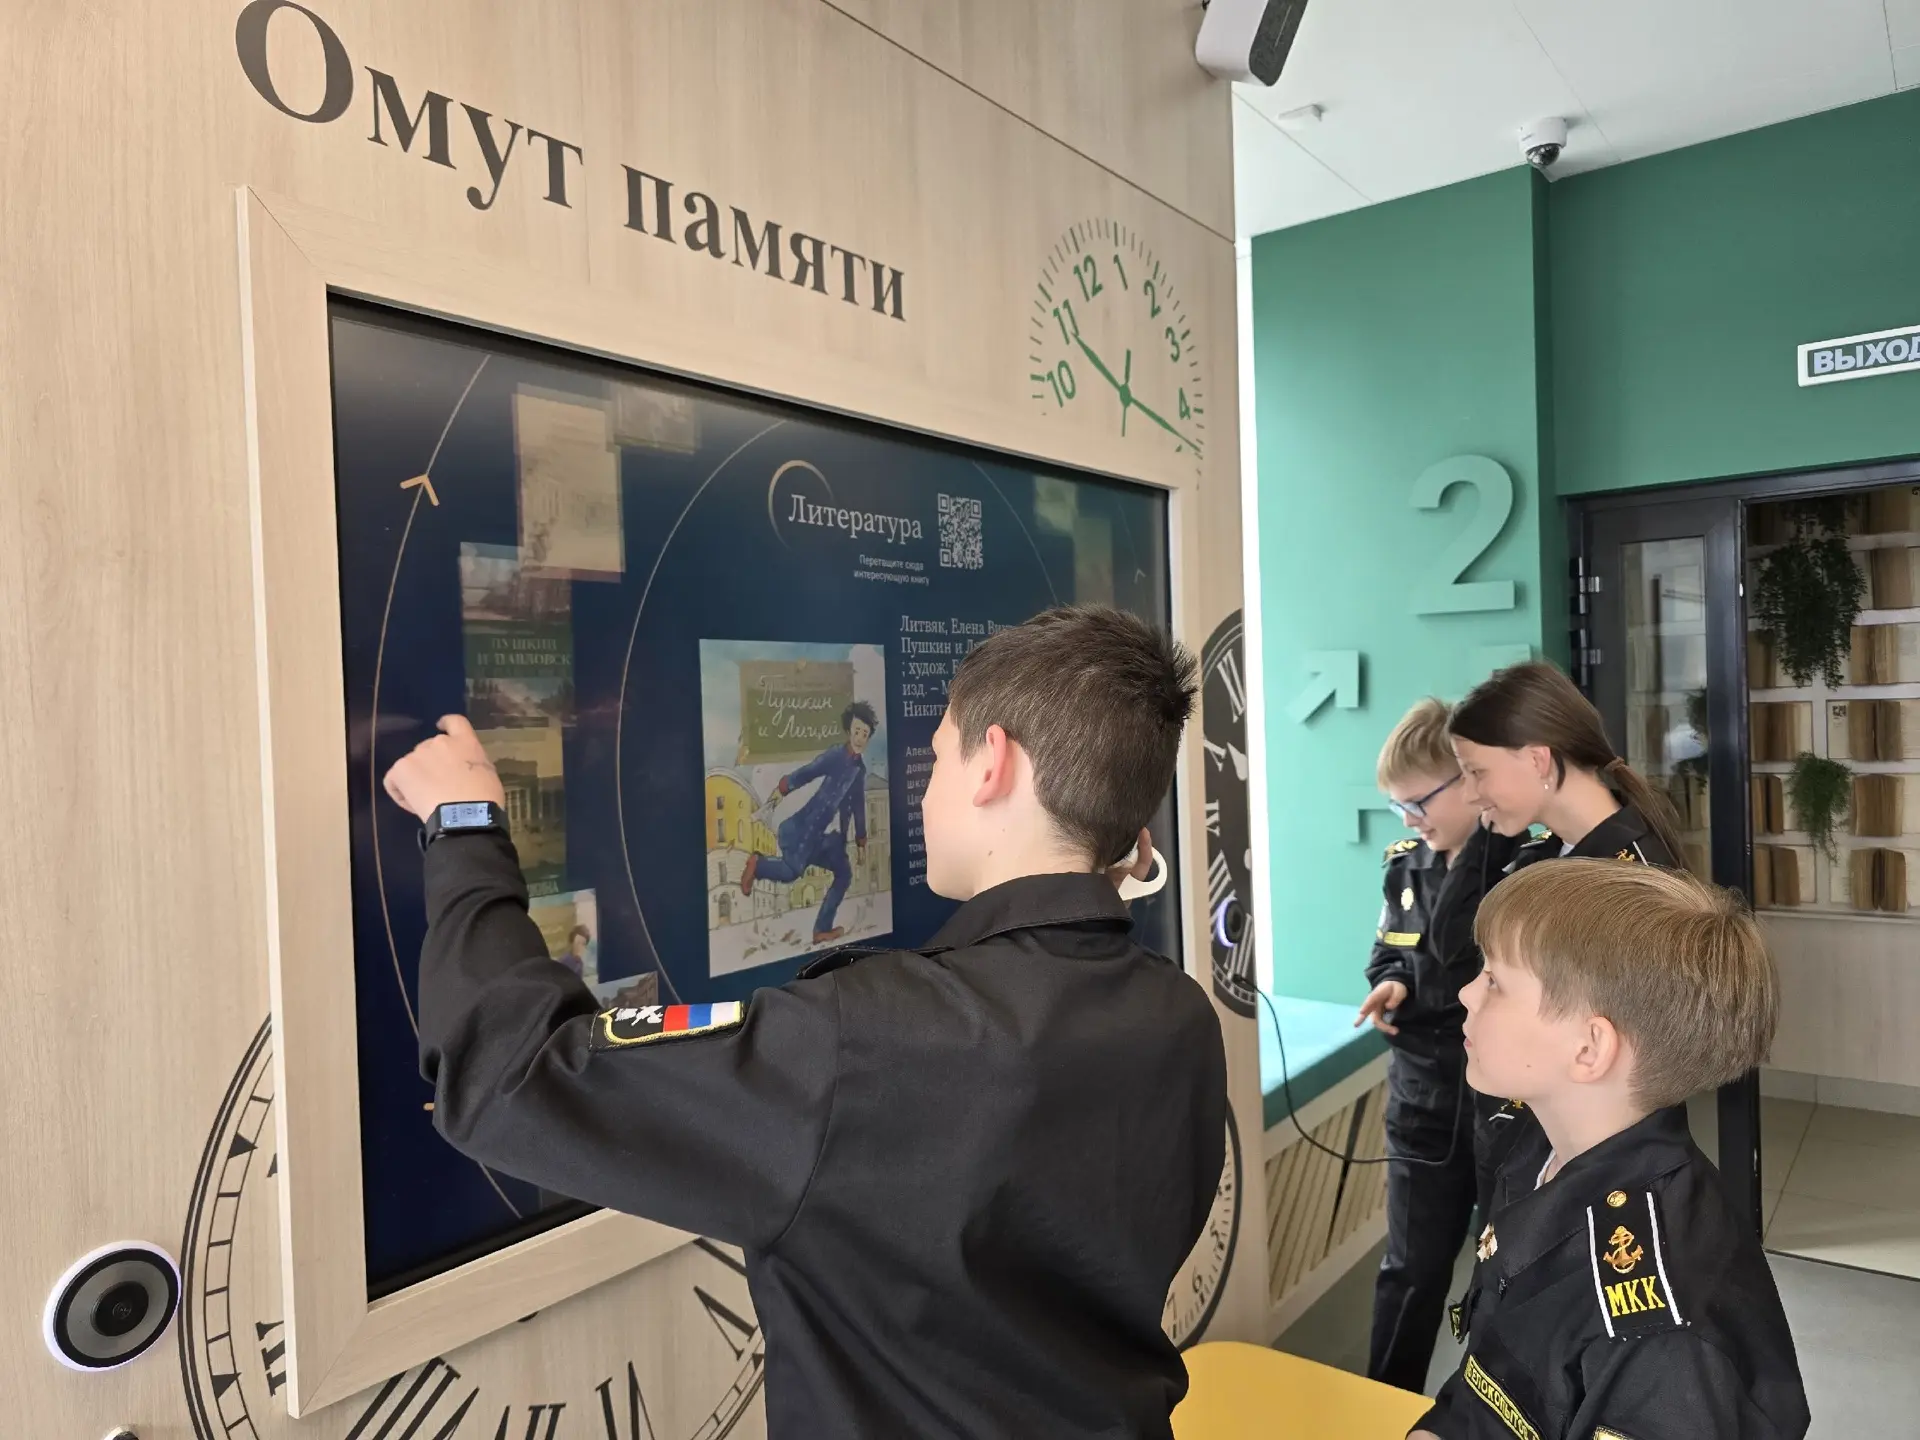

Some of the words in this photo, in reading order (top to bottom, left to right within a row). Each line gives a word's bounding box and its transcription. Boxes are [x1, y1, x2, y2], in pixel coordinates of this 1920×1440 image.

[235, 0, 584, 212] Омут
[620, 163, 907, 323] памяти
[1073, 254, 1104, 303] 12
[1143, 280, 1161, 319] 2
[1165, 326, 1181, 363] 3
[1047, 360, 1076, 408] 10
[788, 494, 923, 545] Литература
[1411, 454, 1516, 616] 2
[900, 615, 948, 636] Литвяк,
[951, 618, 985, 635] Елена
[901, 637, 952, 658] Пушкин
[955, 642, 963, 655] и
[908, 660, 949, 679] худож.
[757, 674, 833, 726] Пушкин
[902, 684, 928, 698] изд.
[778, 715, 840, 740] Лицей
[1605, 1276, 1665, 1317] МКК
